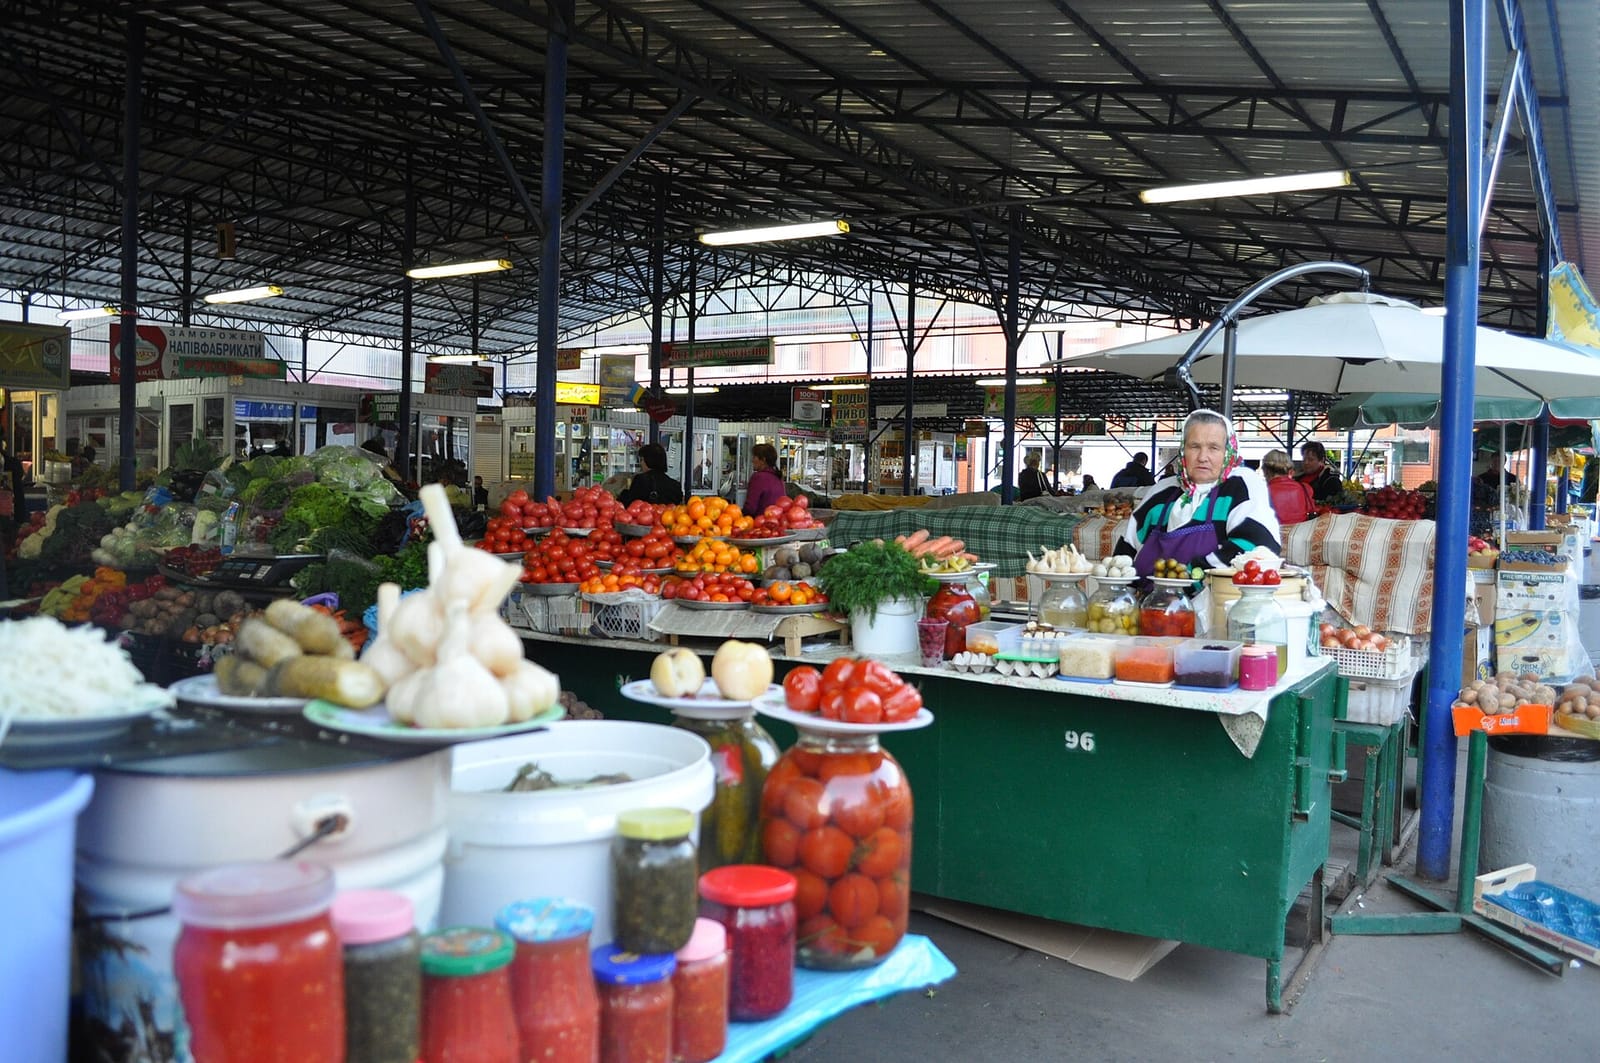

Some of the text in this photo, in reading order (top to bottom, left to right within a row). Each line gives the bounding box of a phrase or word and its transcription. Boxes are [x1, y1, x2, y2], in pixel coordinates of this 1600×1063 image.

[168, 328, 262, 341] ЗАМОРОЖЕНІ
[169, 340, 262, 358] НАПІВФАБРИКАТИ
[799, 391, 818, 399] 100%
[837, 393, 867, 405] ВОДЫ
[836, 408, 866, 420] ПИВО
[1064, 730, 1096, 752] 96
